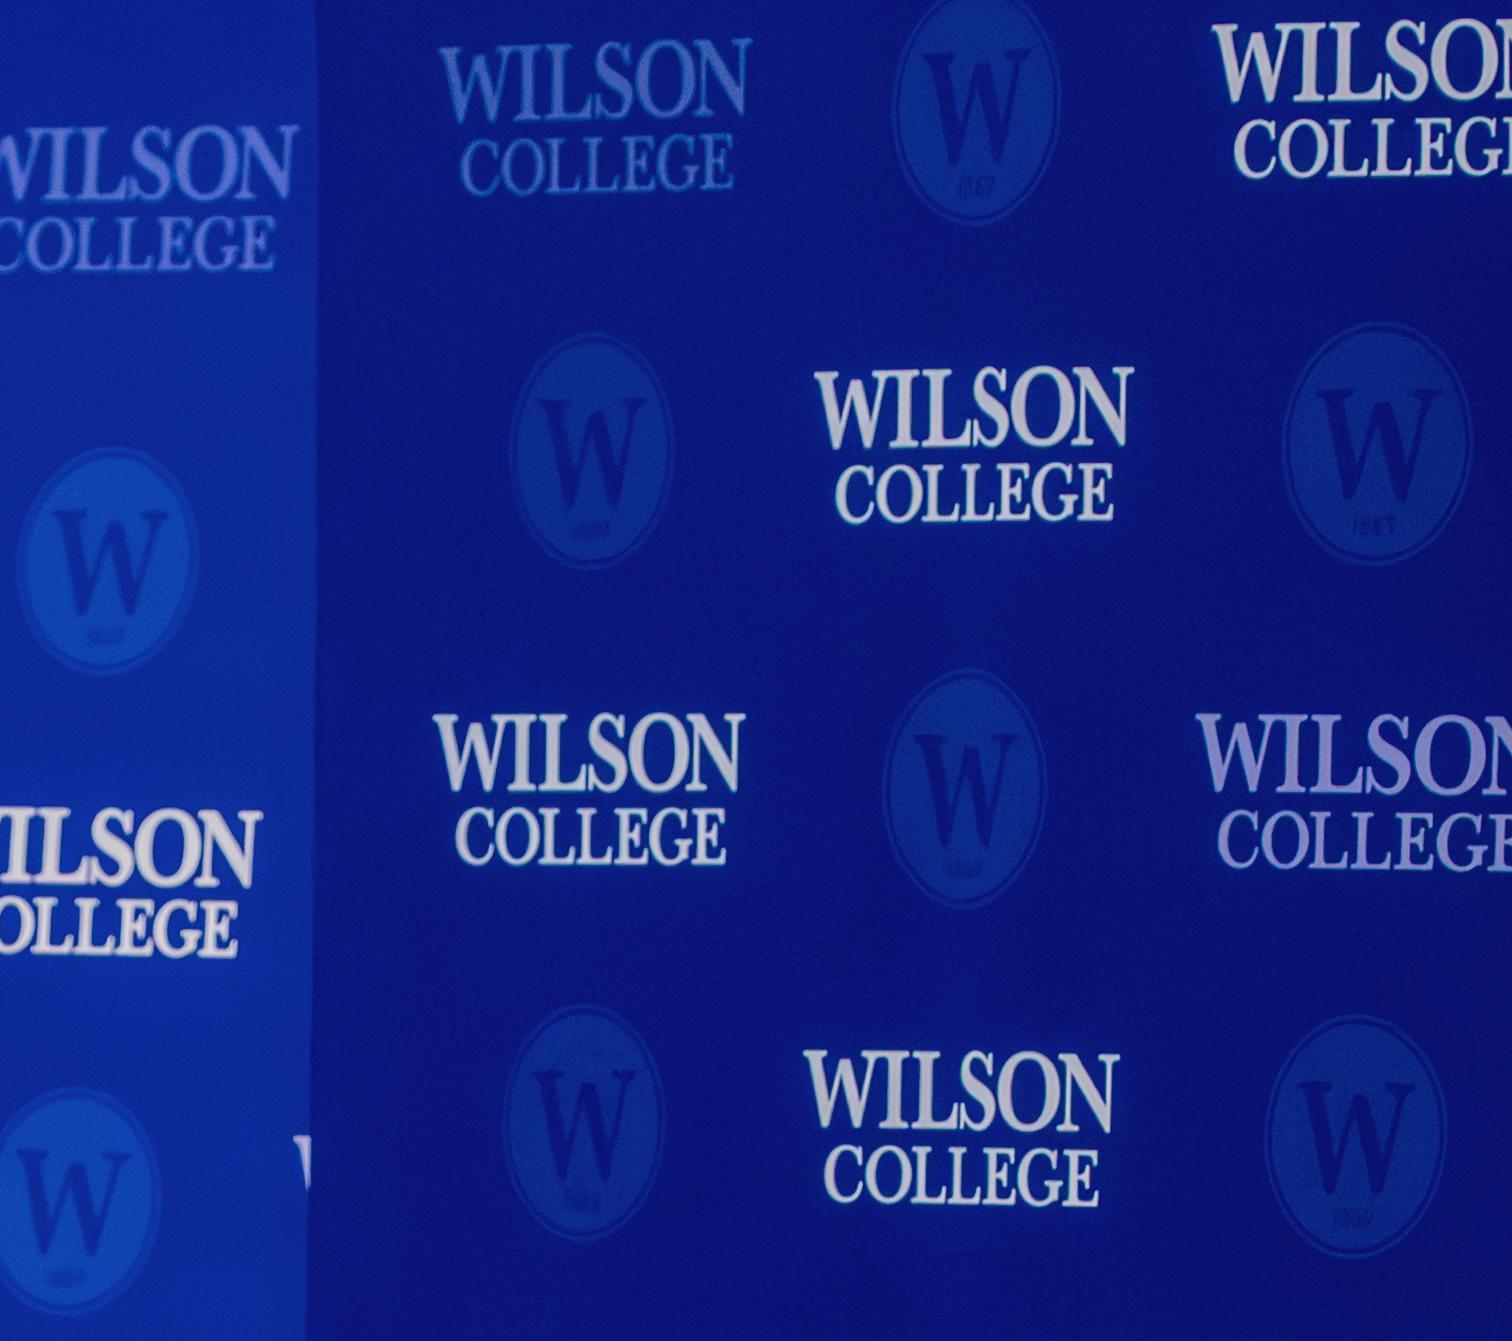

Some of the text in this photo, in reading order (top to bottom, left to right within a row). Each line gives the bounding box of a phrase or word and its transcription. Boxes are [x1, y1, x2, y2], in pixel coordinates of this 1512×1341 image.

[439, 38, 752, 123] WILSON
[923, 49, 1031, 163] W
[461, 134, 733, 196] COLLEGE
[538, 398, 646, 509] W
[814, 366, 1134, 449] WILSON
[1317, 388, 1442, 501] W
[836, 462, 1113, 524] COLLEGE
[54, 510, 168, 615] W
[433, 712, 746, 793] WILSON
[914, 734, 1016, 847] W
[456, 807, 726, 866] COLLEGE
[533, 1070, 636, 1180] W
[803, 1050, 1120, 1133] WILSON
[1298, 1081, 1415, 1194] W
[17, 1149, 131, 1256] W
[824, 1144, 1099, 1207] COLLEGE
